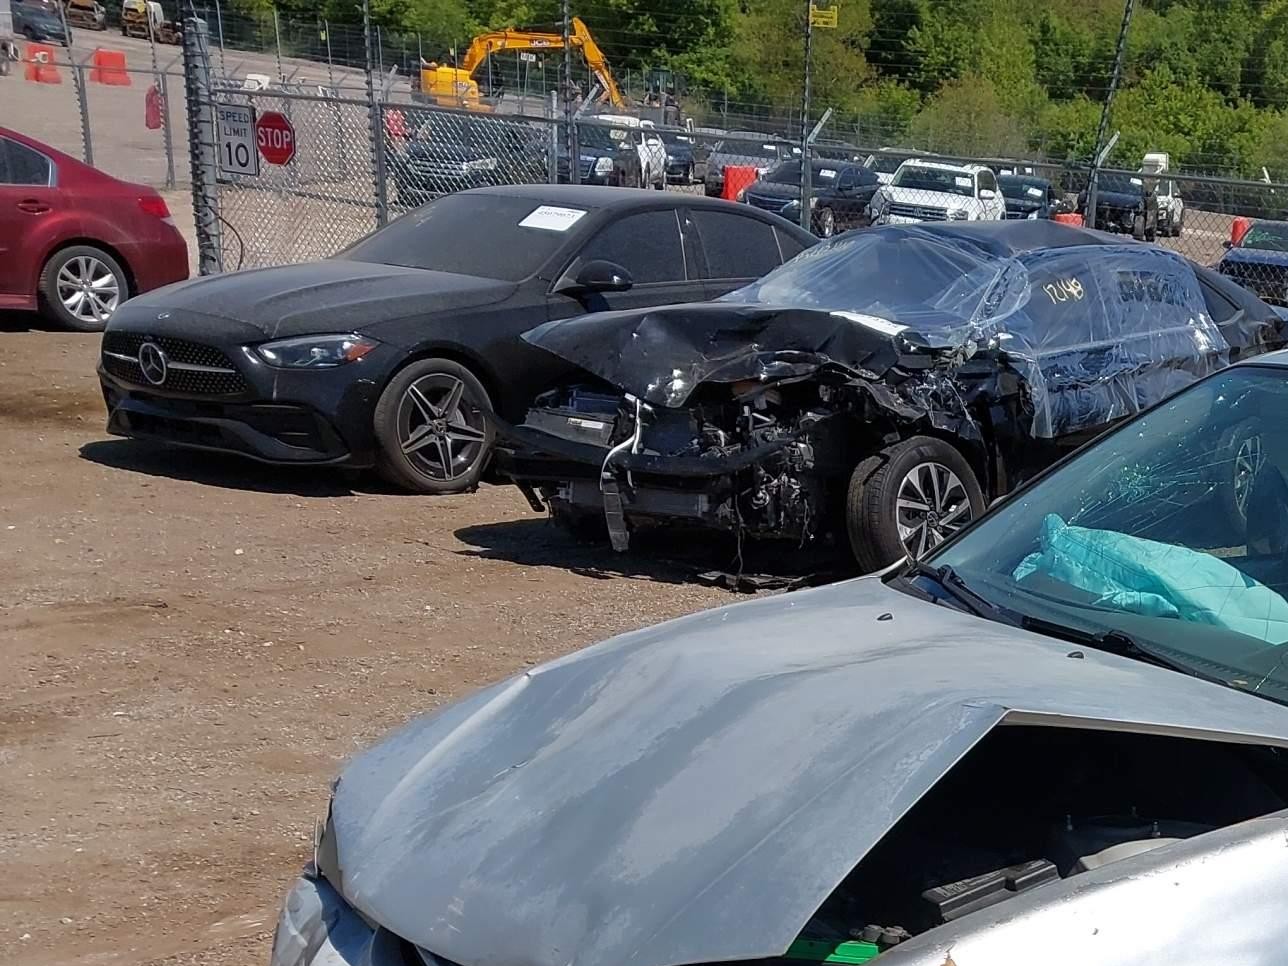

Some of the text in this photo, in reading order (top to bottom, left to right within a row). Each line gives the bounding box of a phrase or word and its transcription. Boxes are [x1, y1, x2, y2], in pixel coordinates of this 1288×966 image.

[219, 111, 249, 124] SPEED
[223, 126, 247, 138] LIMIT
[257, 126, 291, 150] STOP
[225, 141, 250, 168] 10
